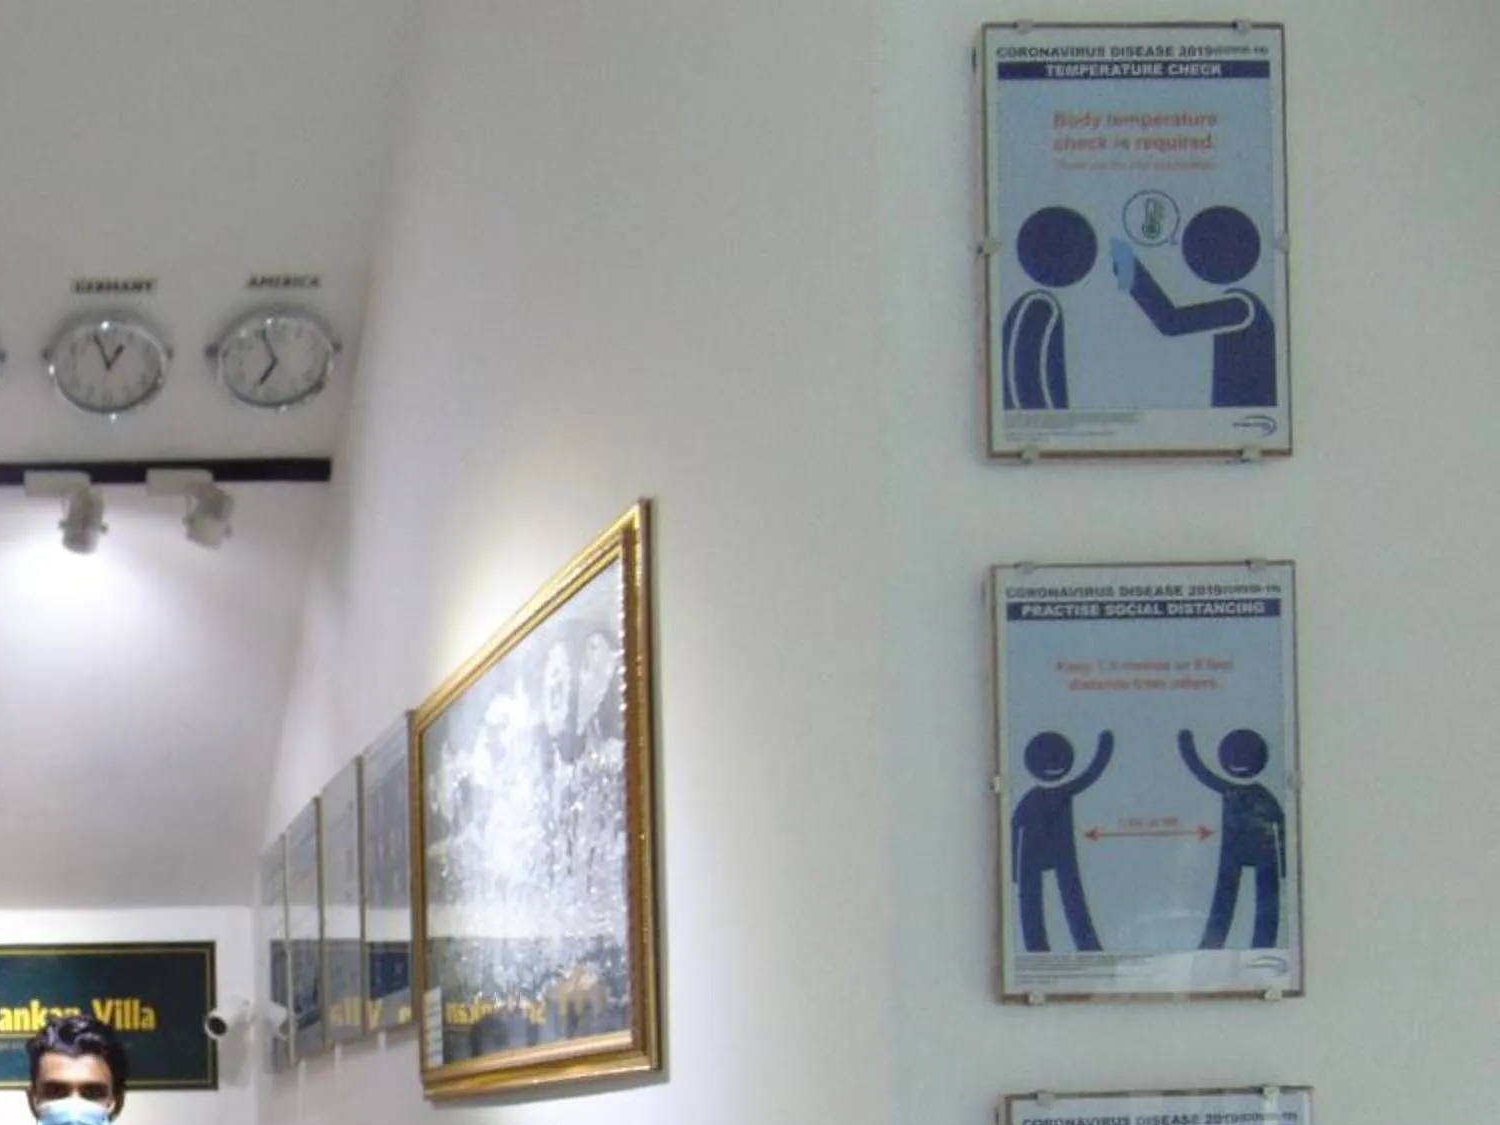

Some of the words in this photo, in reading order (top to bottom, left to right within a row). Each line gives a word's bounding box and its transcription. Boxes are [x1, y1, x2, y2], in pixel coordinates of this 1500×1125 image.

[997, 46, 1104, 58] CORONAVIRUS
[1111, 46, 1173, 58] DISEASE
[1044, 63, 1163, 77] TEMPERATURE
[1168, 63, 1221, 77] CHECK
[1055, 111, 1099, 129] Body
[1107, 111, 1217, 129] temperature
[1054, 134, 1106, 151] check
[71, 279, 156, 294] GERMANY
[247, 275, 321, 289] AMERICA
[1006, 586, 1113, 598] CORONAVIRUS
[1119, 585, 1183, 597] DISEASE
[1021, 603, 1100, 618] PRACTISE
[1105, 602, 1162, 617] SOCIAL
[1167, 600, 1266, 616] DISTANCING
[91, 998, 157, 1031] Villa
